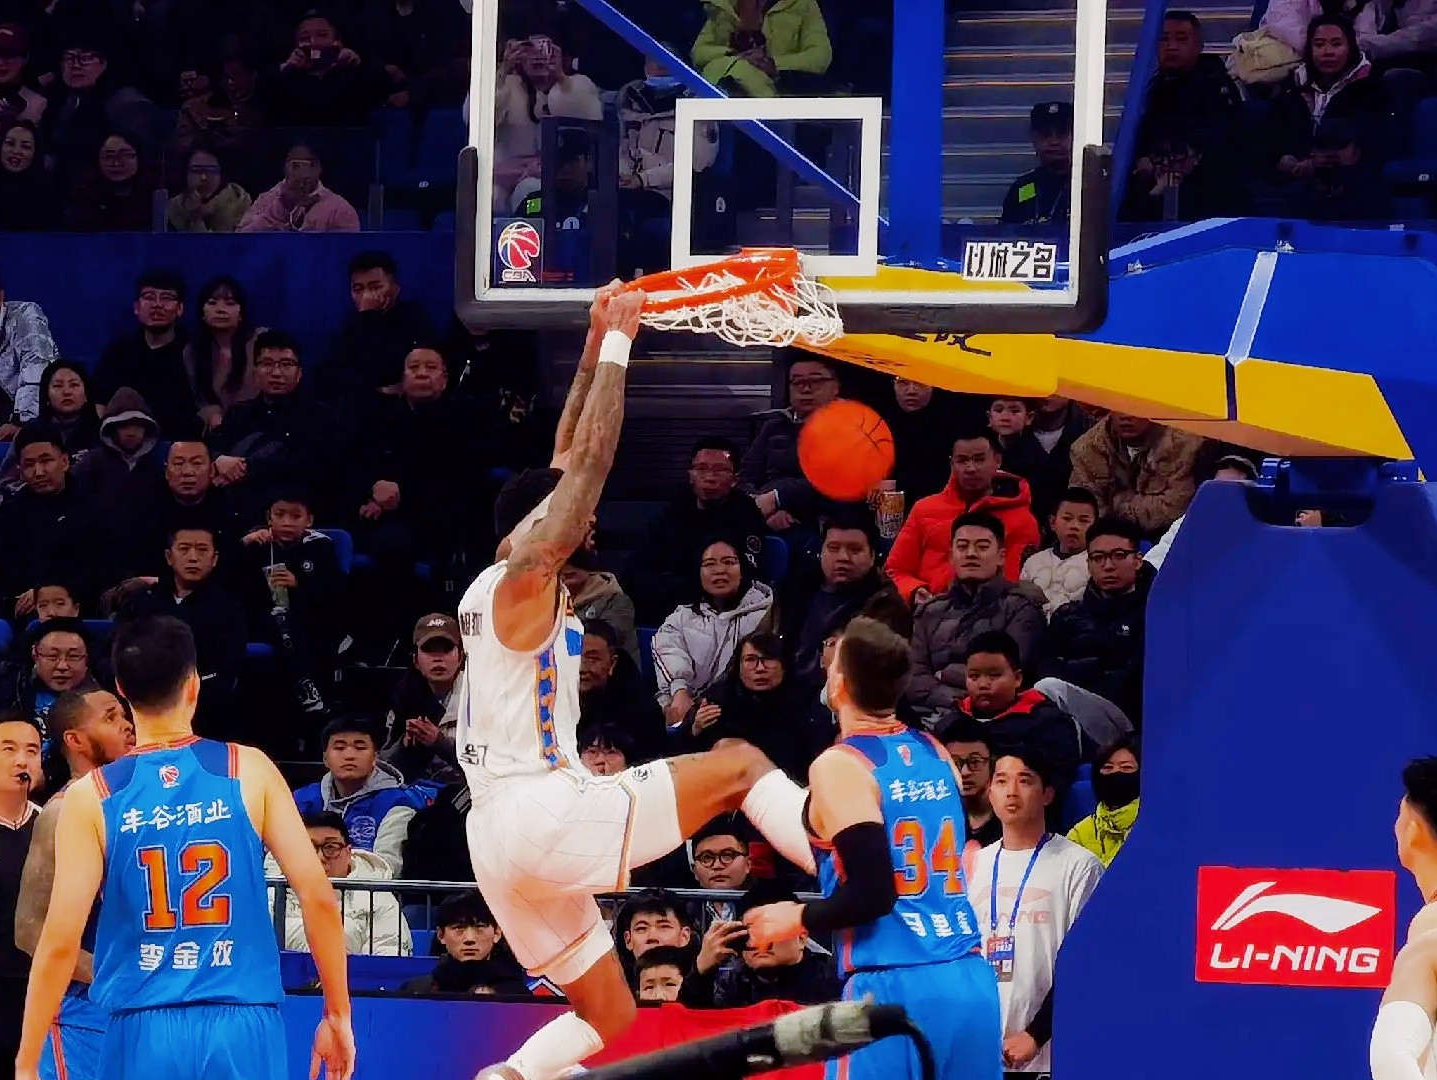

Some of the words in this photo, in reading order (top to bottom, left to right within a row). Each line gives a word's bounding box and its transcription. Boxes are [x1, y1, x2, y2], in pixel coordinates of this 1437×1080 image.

[966, 243, 1053, 279] 以城之名
[120, 799, 232, 834] 丰谷酒业
[893, 816, 966, 900] 34
[135, 838, 232, 933] 12
[1210, 943, 1379, 974] LI-NING
